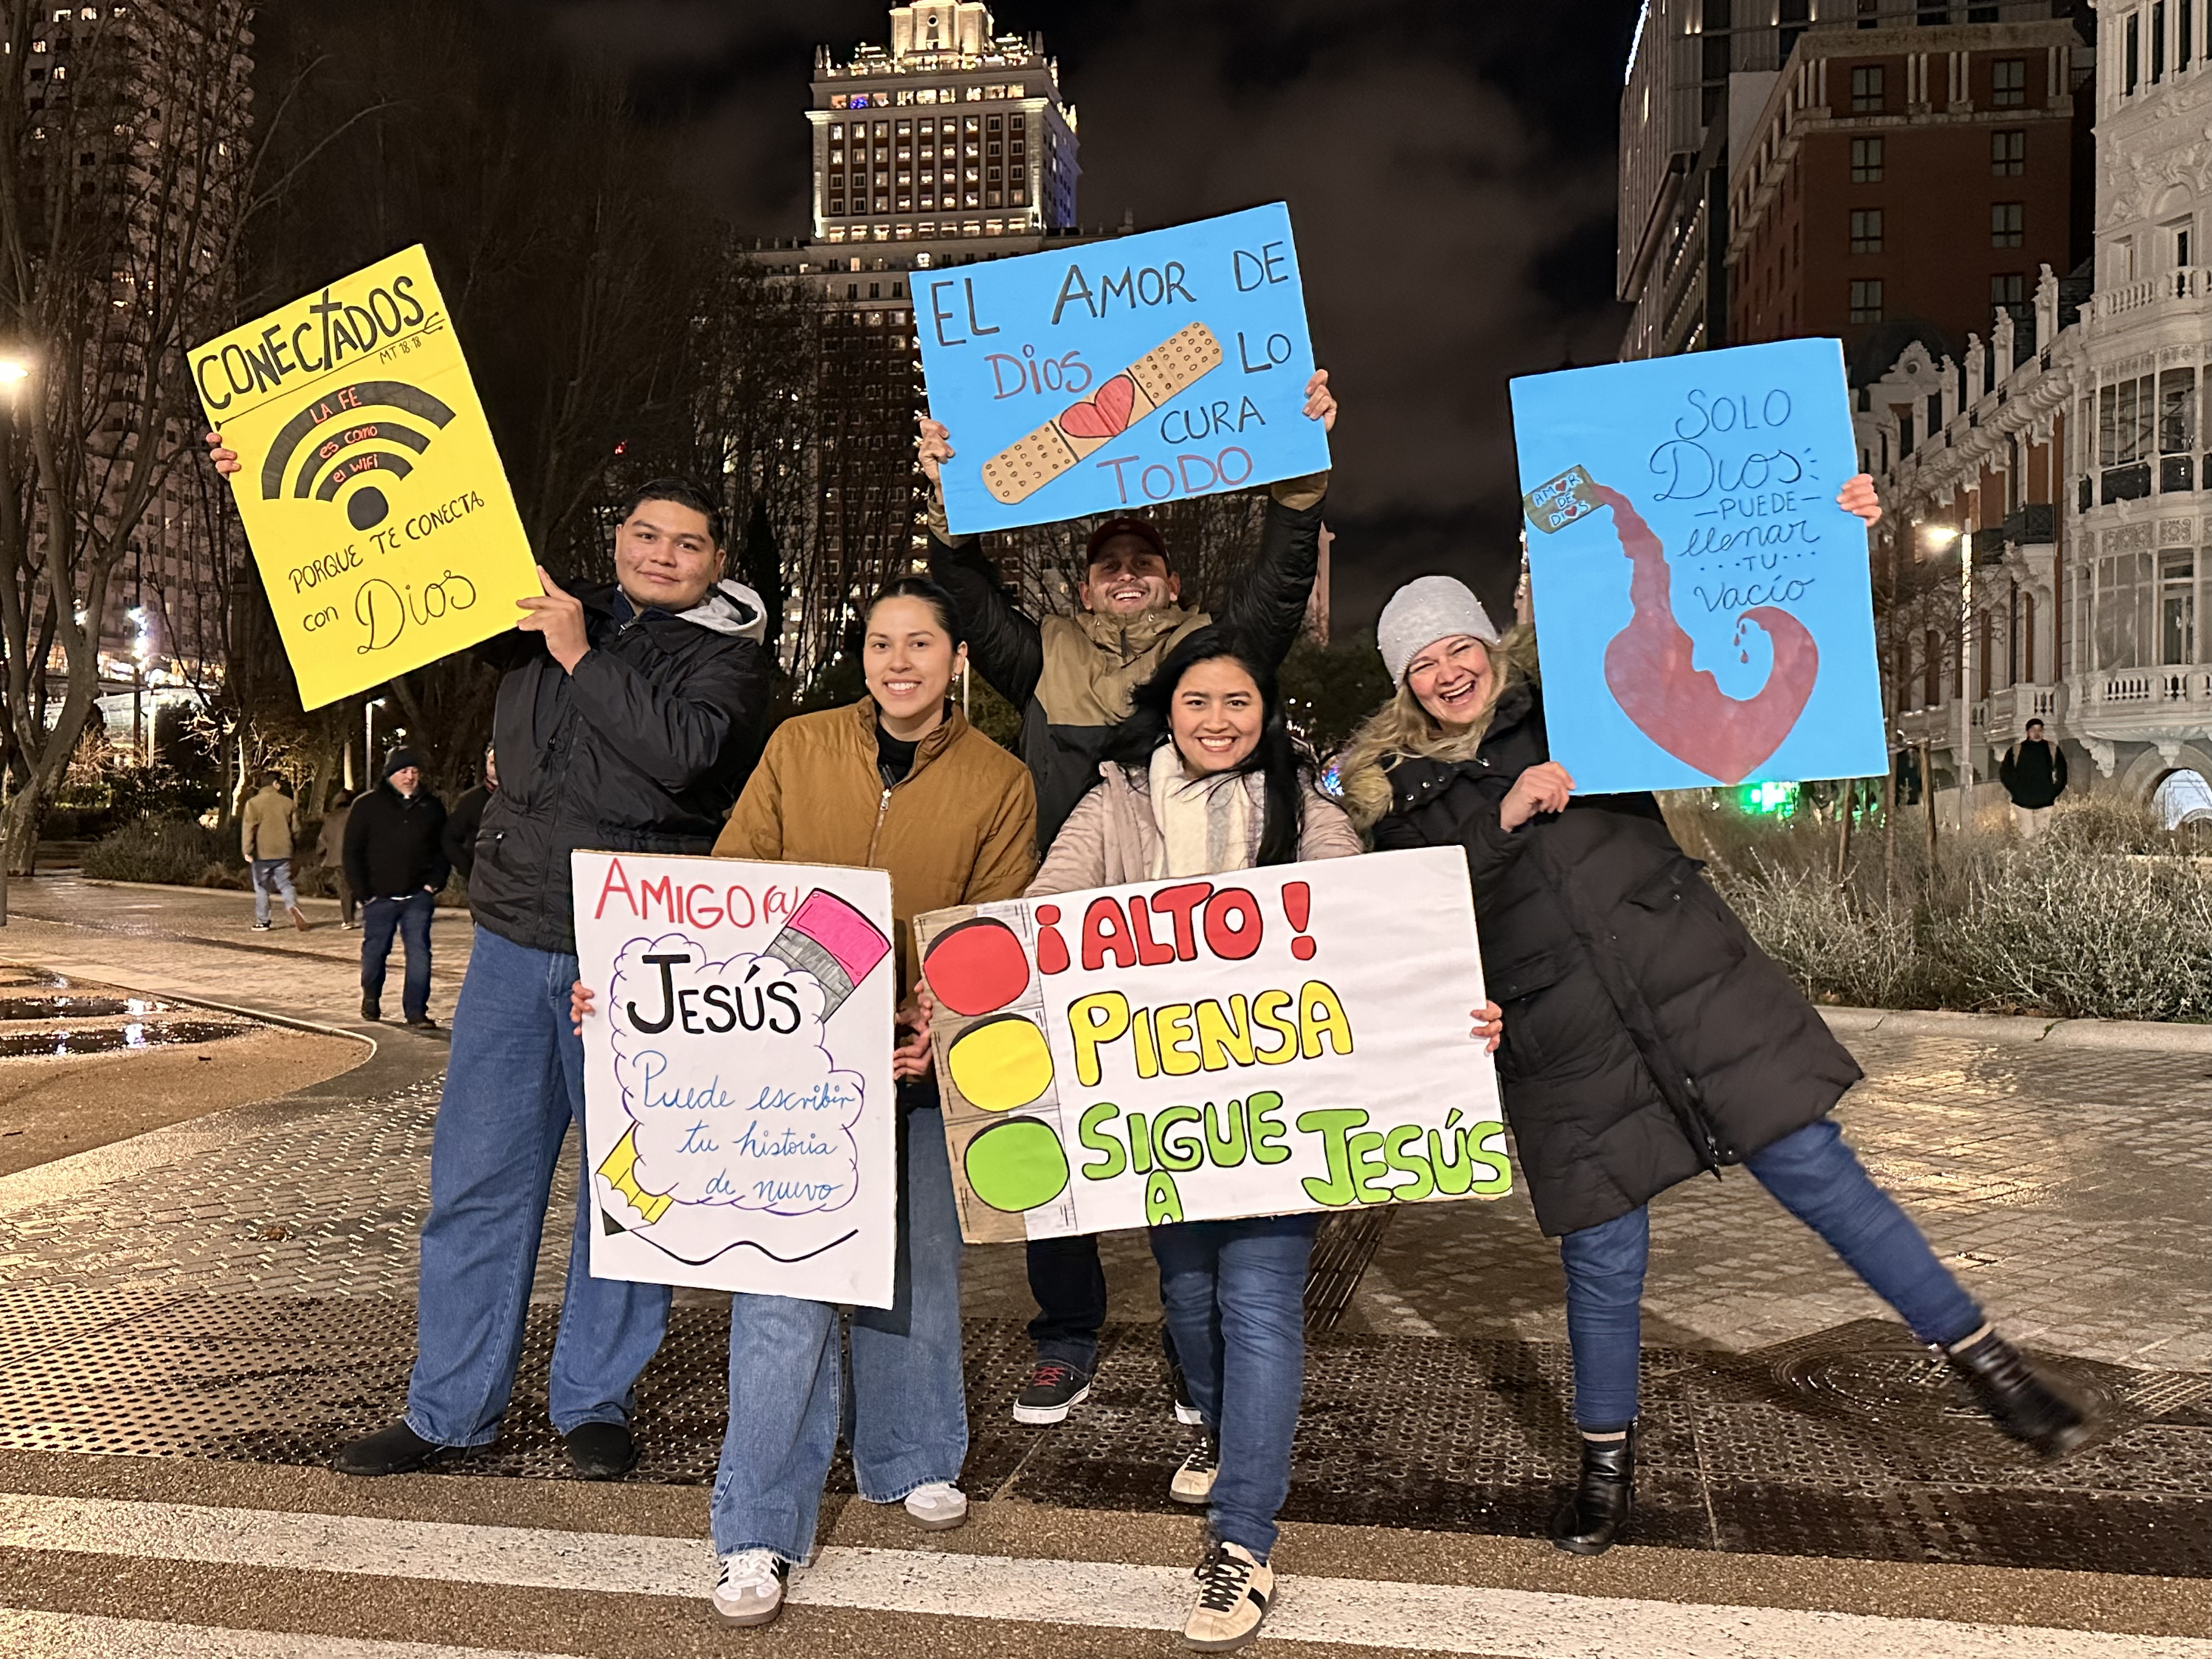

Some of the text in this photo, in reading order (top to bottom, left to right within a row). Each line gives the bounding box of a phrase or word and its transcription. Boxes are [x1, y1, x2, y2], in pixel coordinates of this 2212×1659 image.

[931, 241, 1288, 347] EL AMOR DE
[380, 336, 421, 364] MT 18:18
[1238, 332, 1291, 374] LO
[309, 387, 362, 424] LA FE
[1161, 396, 1266, 444] CURA
[1675, 389, 1791, 439] SOLO
[319, 441, 339, 459] es
[1650, 440, 1802, 500] Dios
[1096, 447, 1253, 504] TODO
[1557, 494, 1574, 507] DE
[289, 490, 484, 594] PORQUE TE CONECTA
[1679, 520, 1821, 556] llenar
[303, 569, 477, 654] con Dios
[627, 954, 801, 1035] JESÚS
[1067, 980, 1353, 1087] PIENSA
[633, 1051, 856, 1111] Puede escribir
[676, 1120, 838, 1158] tu historia
[1079, 1090, 1513, 1227] SIGUE A JESÚS
[706, 1168, 844, 1203] de nuevo
